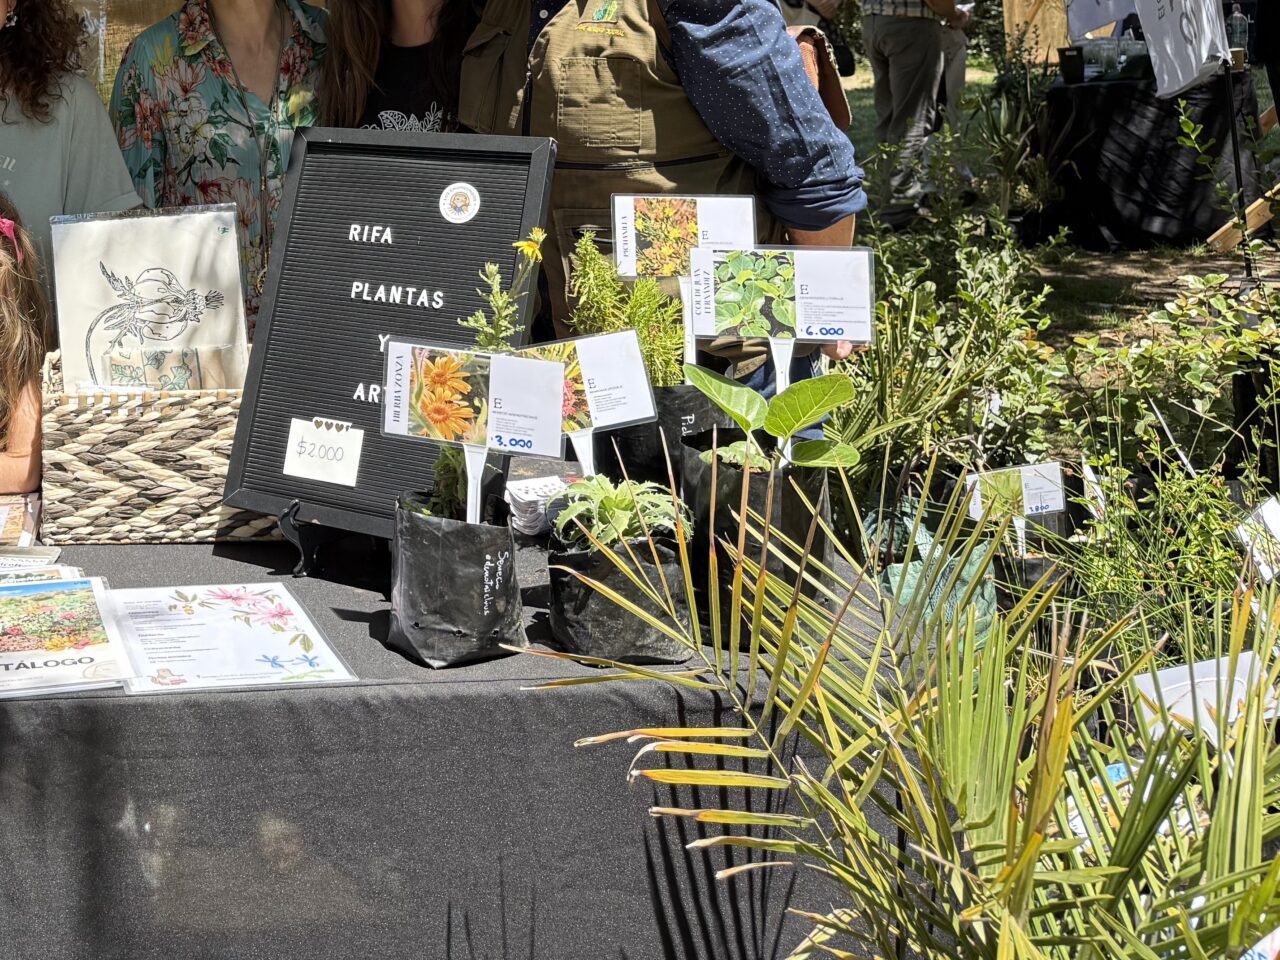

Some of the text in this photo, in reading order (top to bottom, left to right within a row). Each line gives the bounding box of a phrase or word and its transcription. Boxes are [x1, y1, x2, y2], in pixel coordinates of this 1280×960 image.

[348, 224, 393, 244] RIFA
[350, 281, 445, 310] PLANTAS
[800, 284, 809, 295] E
[805, 325, 845, 336] 6.000
[378, 334, 390, 352] Y
[353, 382, 388, 404] AR
[493, 397, 503, 409] E
[494, 434, 533, 449] 3.000
